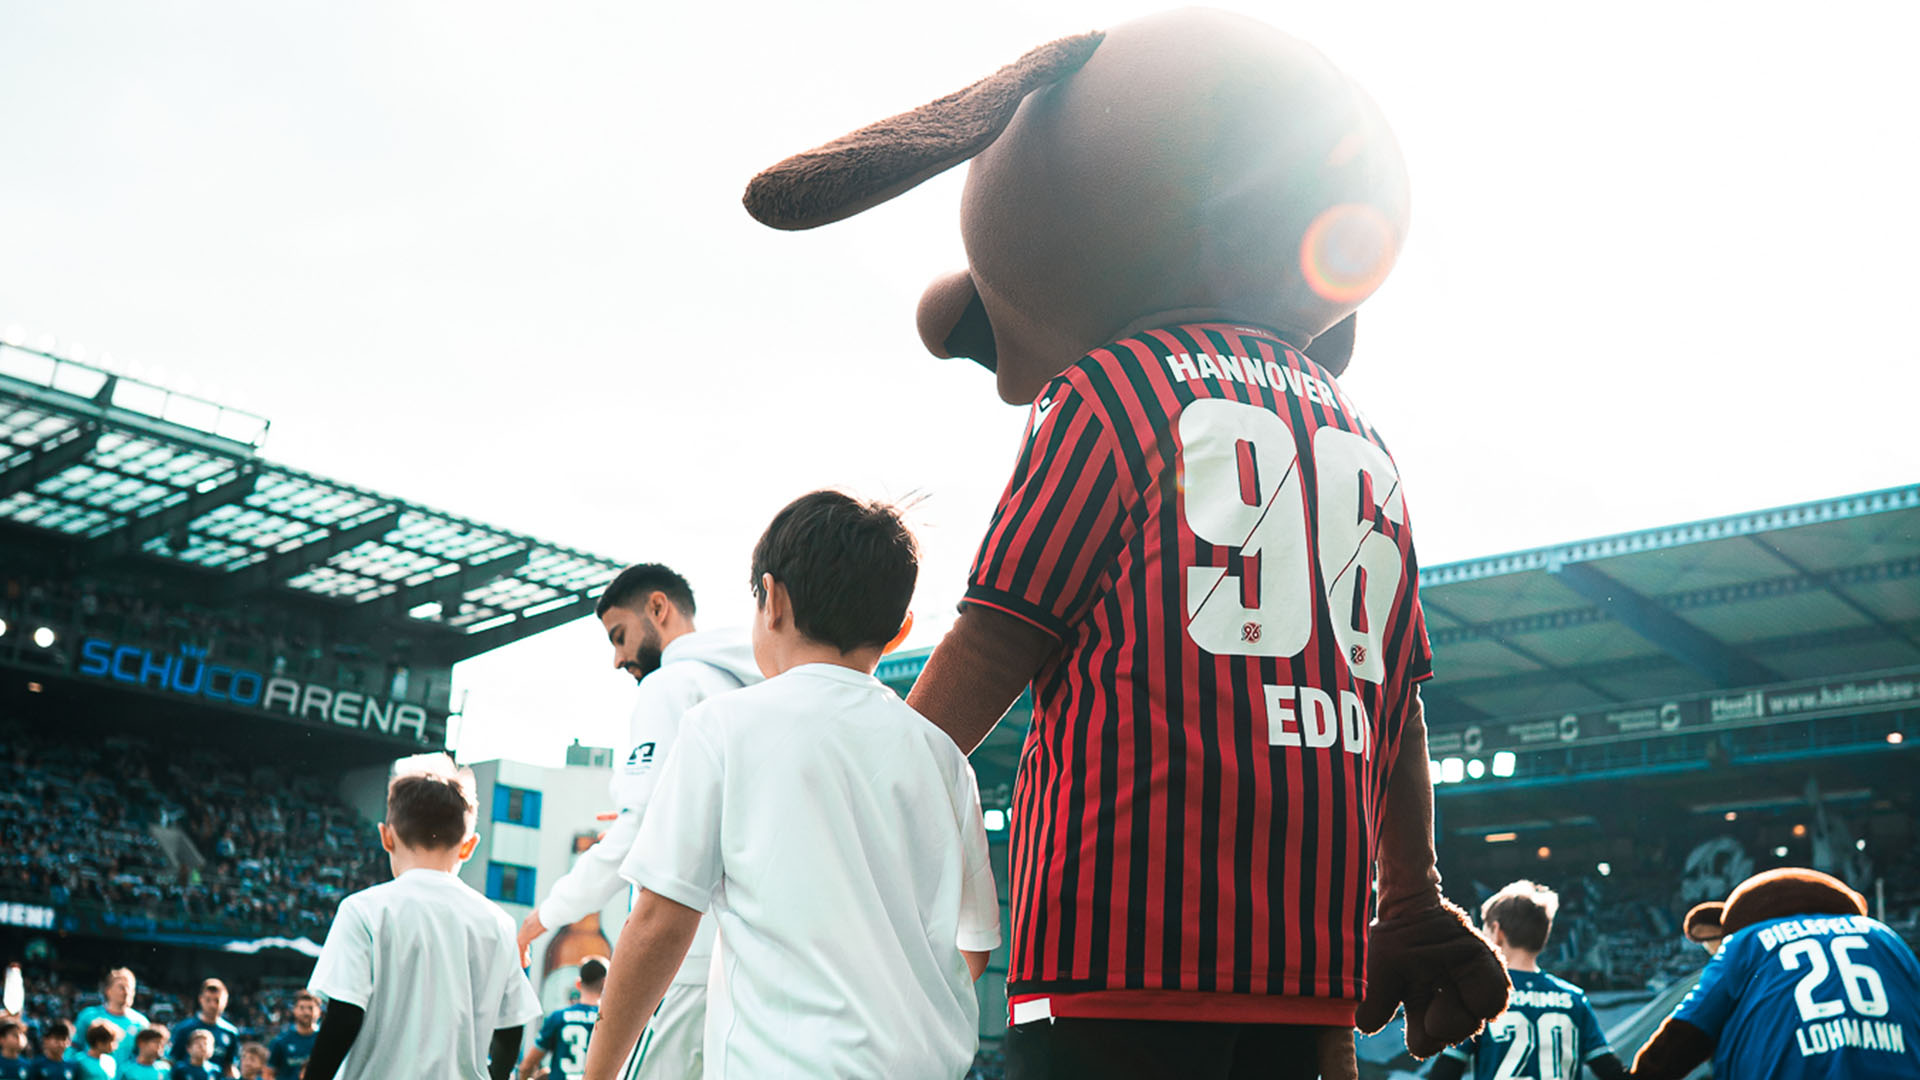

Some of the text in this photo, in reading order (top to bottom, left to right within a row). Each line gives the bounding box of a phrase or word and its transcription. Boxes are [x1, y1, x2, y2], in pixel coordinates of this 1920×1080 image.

[1165, 352, 1340, 411] HANNOVER
[1178, 397, 1404, 686] 96
[1241, 621, 1262, 644] 96
[80, 638, 428, 741] SCHÜCO ARENA
[1507, 990, 1574, 1009] RMINIS
[1779, 935, 1890, 1023] 26
[560, 1024, 589, 1075] 3
[1488, 1010, 1579, 1080] 20
[1795, 1017, 1906, 1058] LOHMANN
